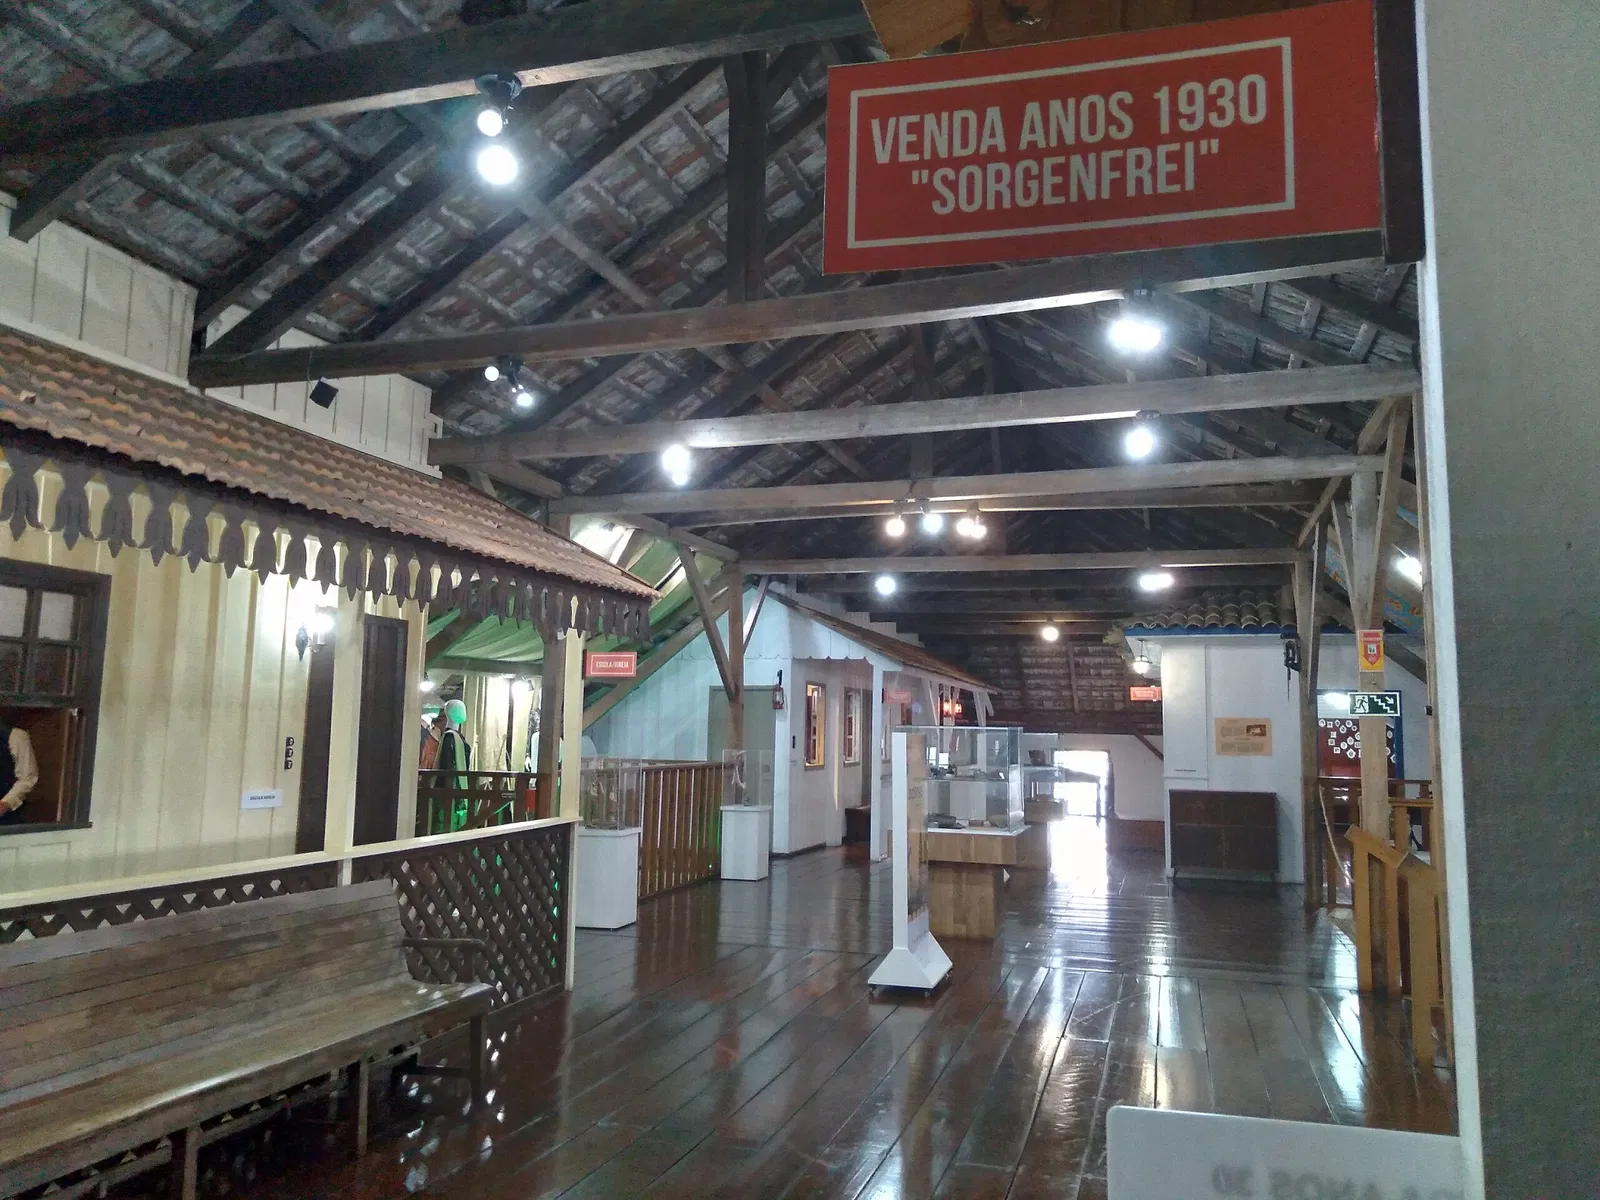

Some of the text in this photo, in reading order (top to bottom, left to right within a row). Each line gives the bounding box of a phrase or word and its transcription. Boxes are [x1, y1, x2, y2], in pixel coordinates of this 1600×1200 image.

[871, 74, 1267, 165] VENDA ANOS 1930
[911, 138, 1219, 215] "SORGENFREI"
